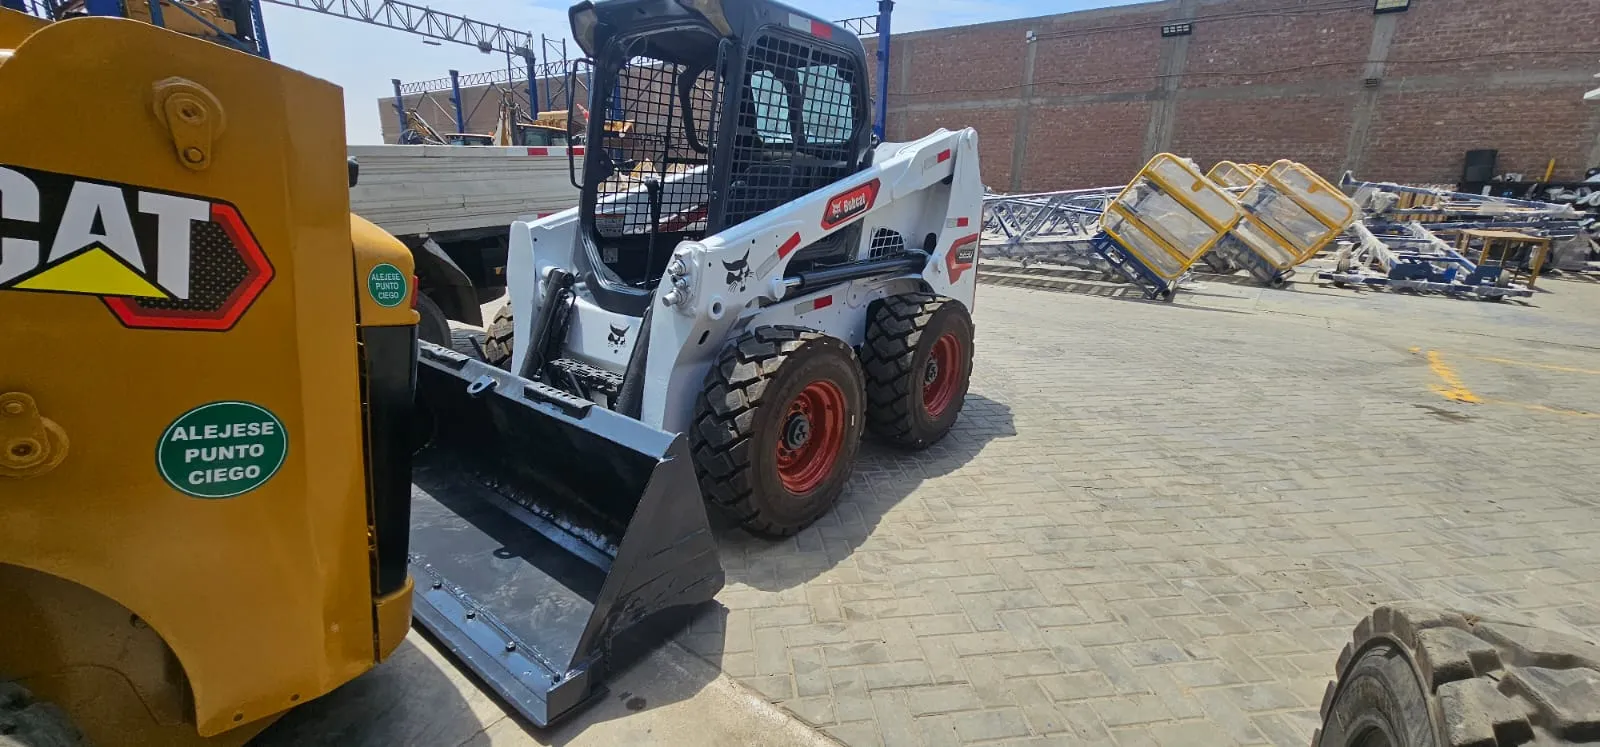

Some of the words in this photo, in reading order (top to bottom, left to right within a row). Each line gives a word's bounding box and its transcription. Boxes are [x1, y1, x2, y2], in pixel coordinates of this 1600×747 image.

[843, 192, 866, 213] Bobcat
[371, 273, 401, 281] ALEJESE
[375, 282, 399, 290] PUNTO
[378, 291, 399, 300] CIEGO
[171, 421, 275, 442] ALEJESE
[185, 443, 265, 463] PUNTO
[188, 465, 260, 485] CIEGO
